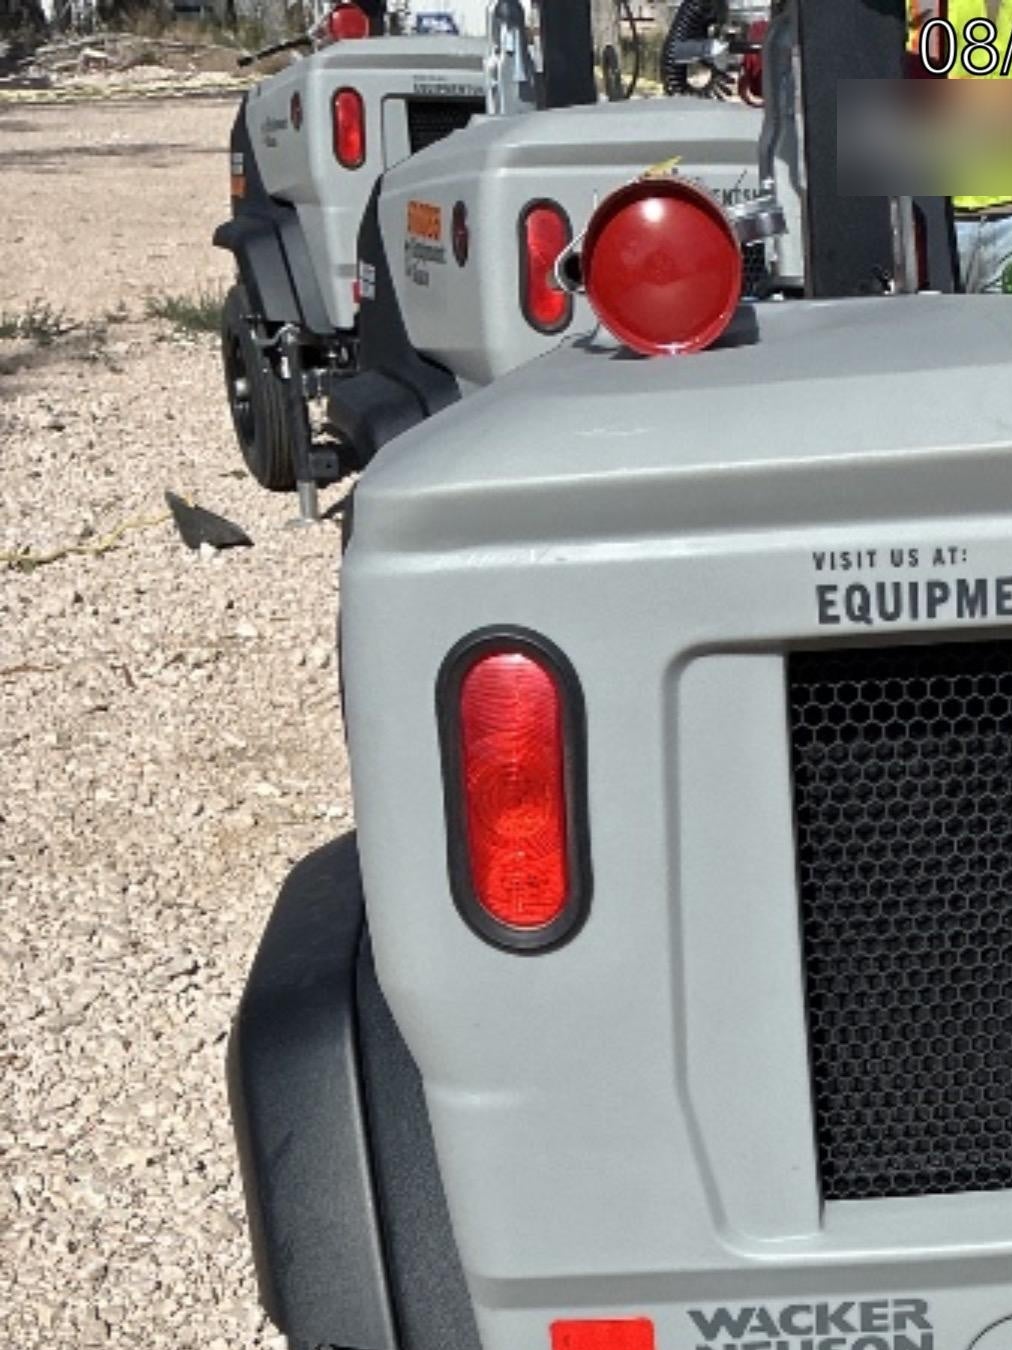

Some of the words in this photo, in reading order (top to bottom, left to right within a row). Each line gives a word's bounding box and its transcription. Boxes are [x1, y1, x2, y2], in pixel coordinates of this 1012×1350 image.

[812, 550, 877, 571] VISIT
[890, 548, 919, 568] US
[932, 546, 967, 567] AT:
[686, 1298, 934, 1341] WACKER
